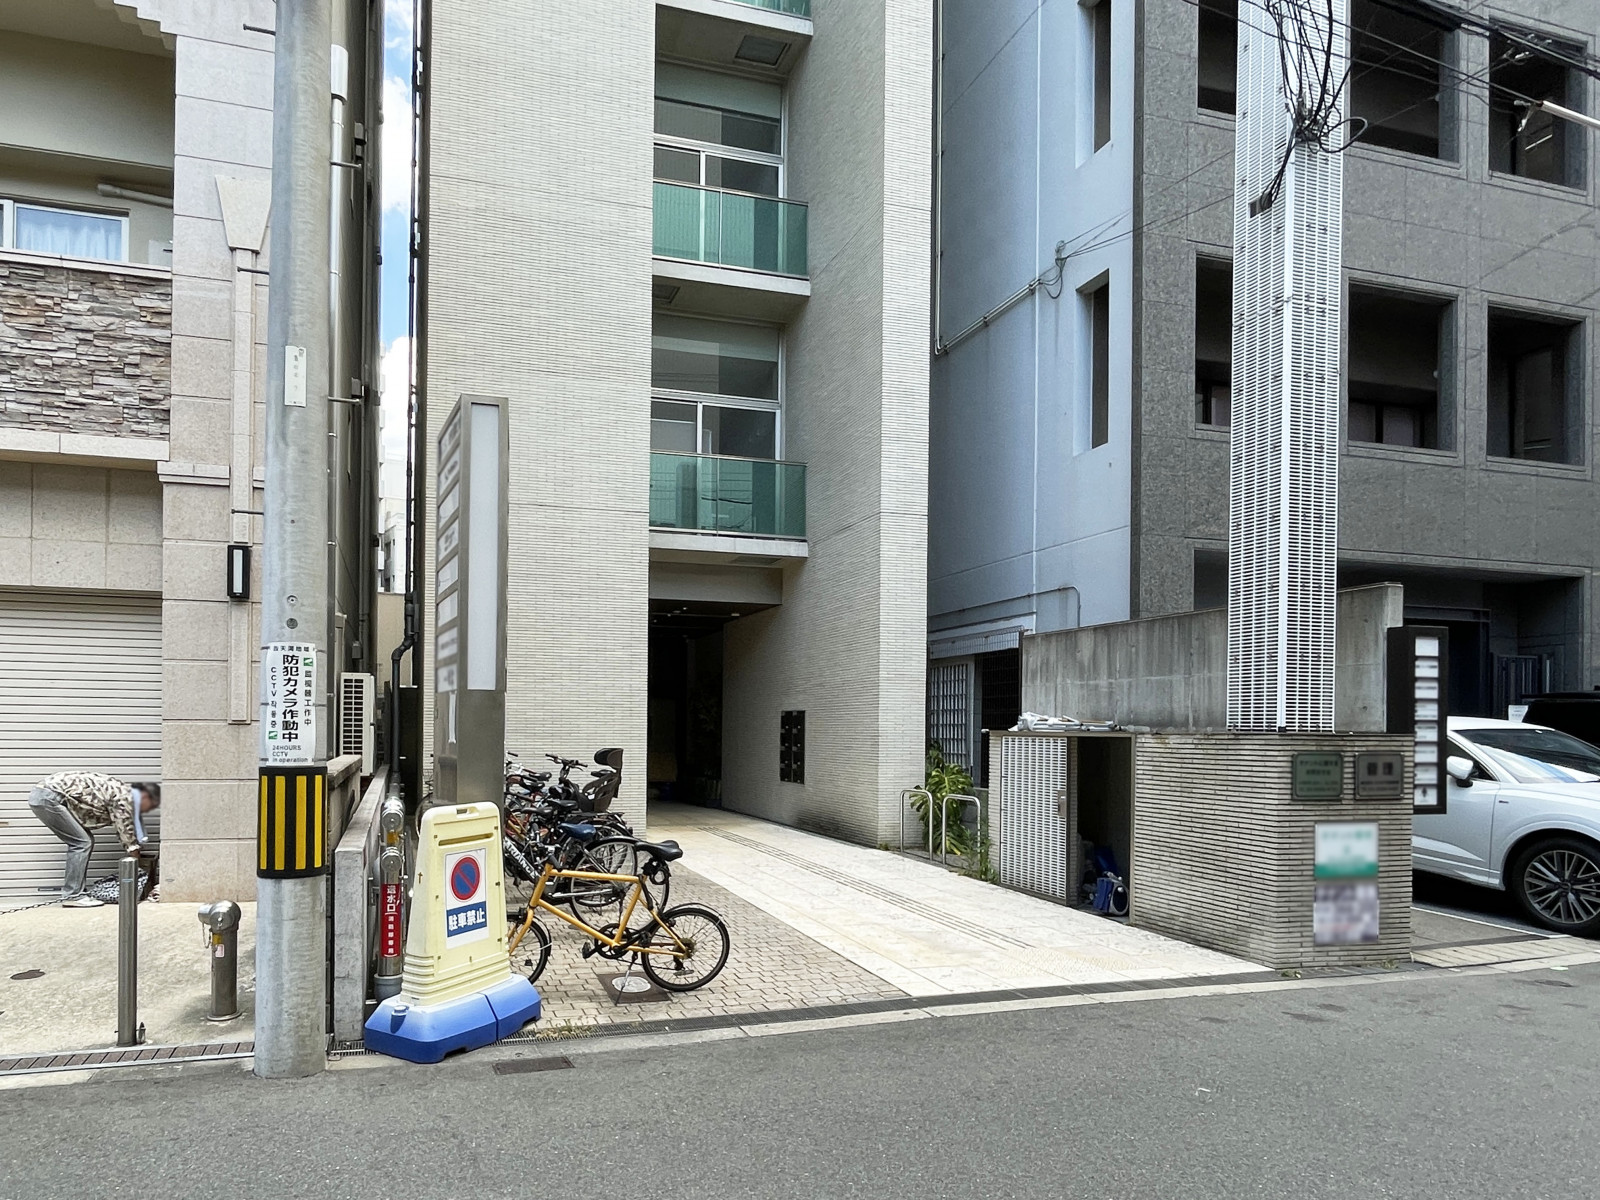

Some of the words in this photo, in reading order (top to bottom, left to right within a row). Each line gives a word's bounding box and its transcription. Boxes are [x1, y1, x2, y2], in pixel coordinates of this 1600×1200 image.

[270, 666, 278, 697] CCTV
[282, 654, 299, 742] 防犯カメラ作動中
[448, 907, 486, 931] 駐車禁止
